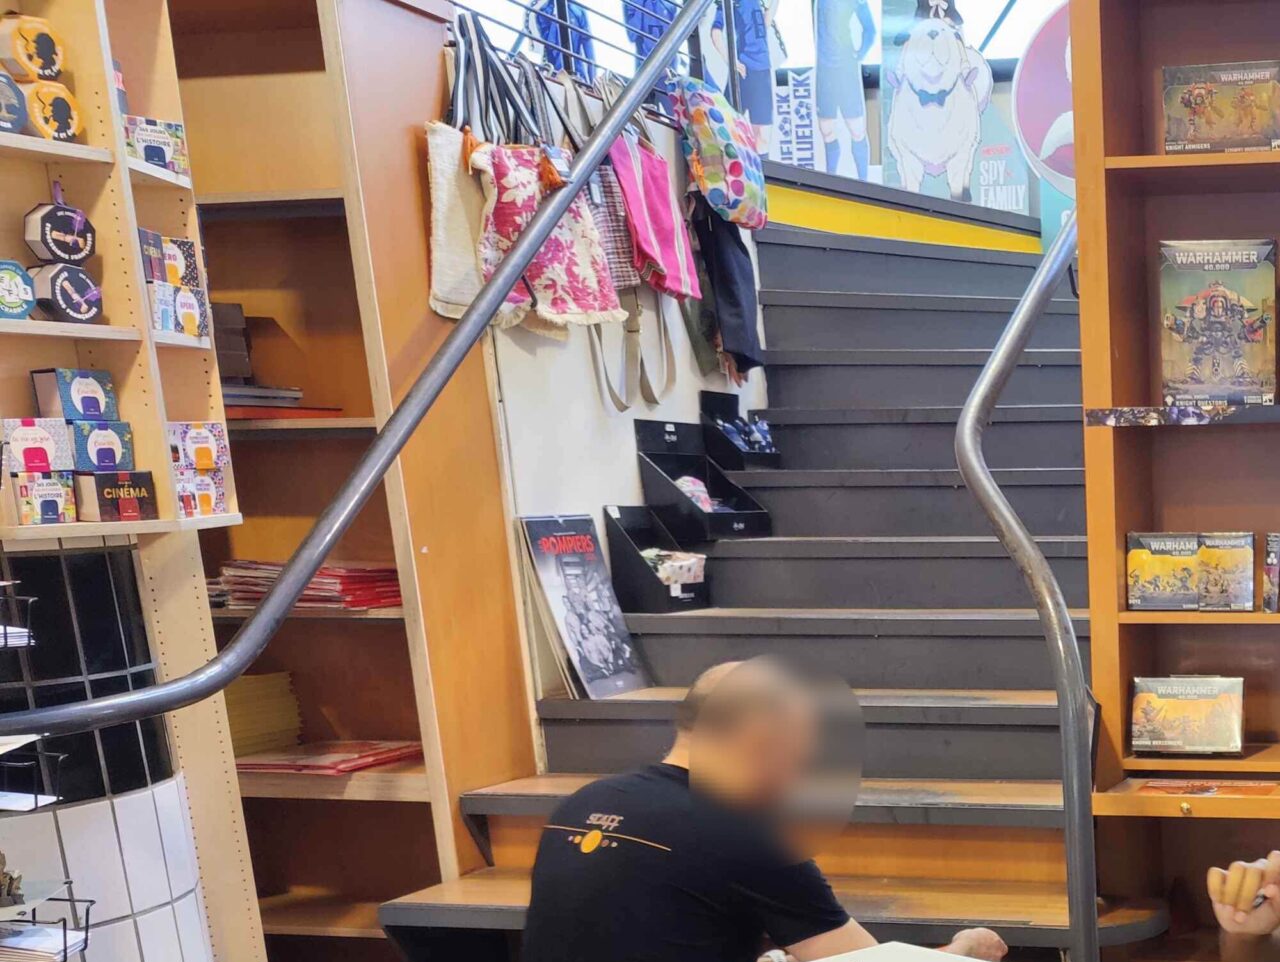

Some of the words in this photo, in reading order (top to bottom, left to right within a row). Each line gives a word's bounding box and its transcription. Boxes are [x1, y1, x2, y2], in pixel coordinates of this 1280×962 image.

[1220, 71, 1271, 82] WARHAMMER
[980, 160, 1006, 186] SPY
[1175, 251, 1258, 264] WARHAMMER
[103, 483, 148, 499] CINÉMA
[1150, 541, 1198, 551] WARHAM
[1205, 539, 1245, 547] WARHAMMER
[1157, 686, 1219, 695] WARHAMMER
